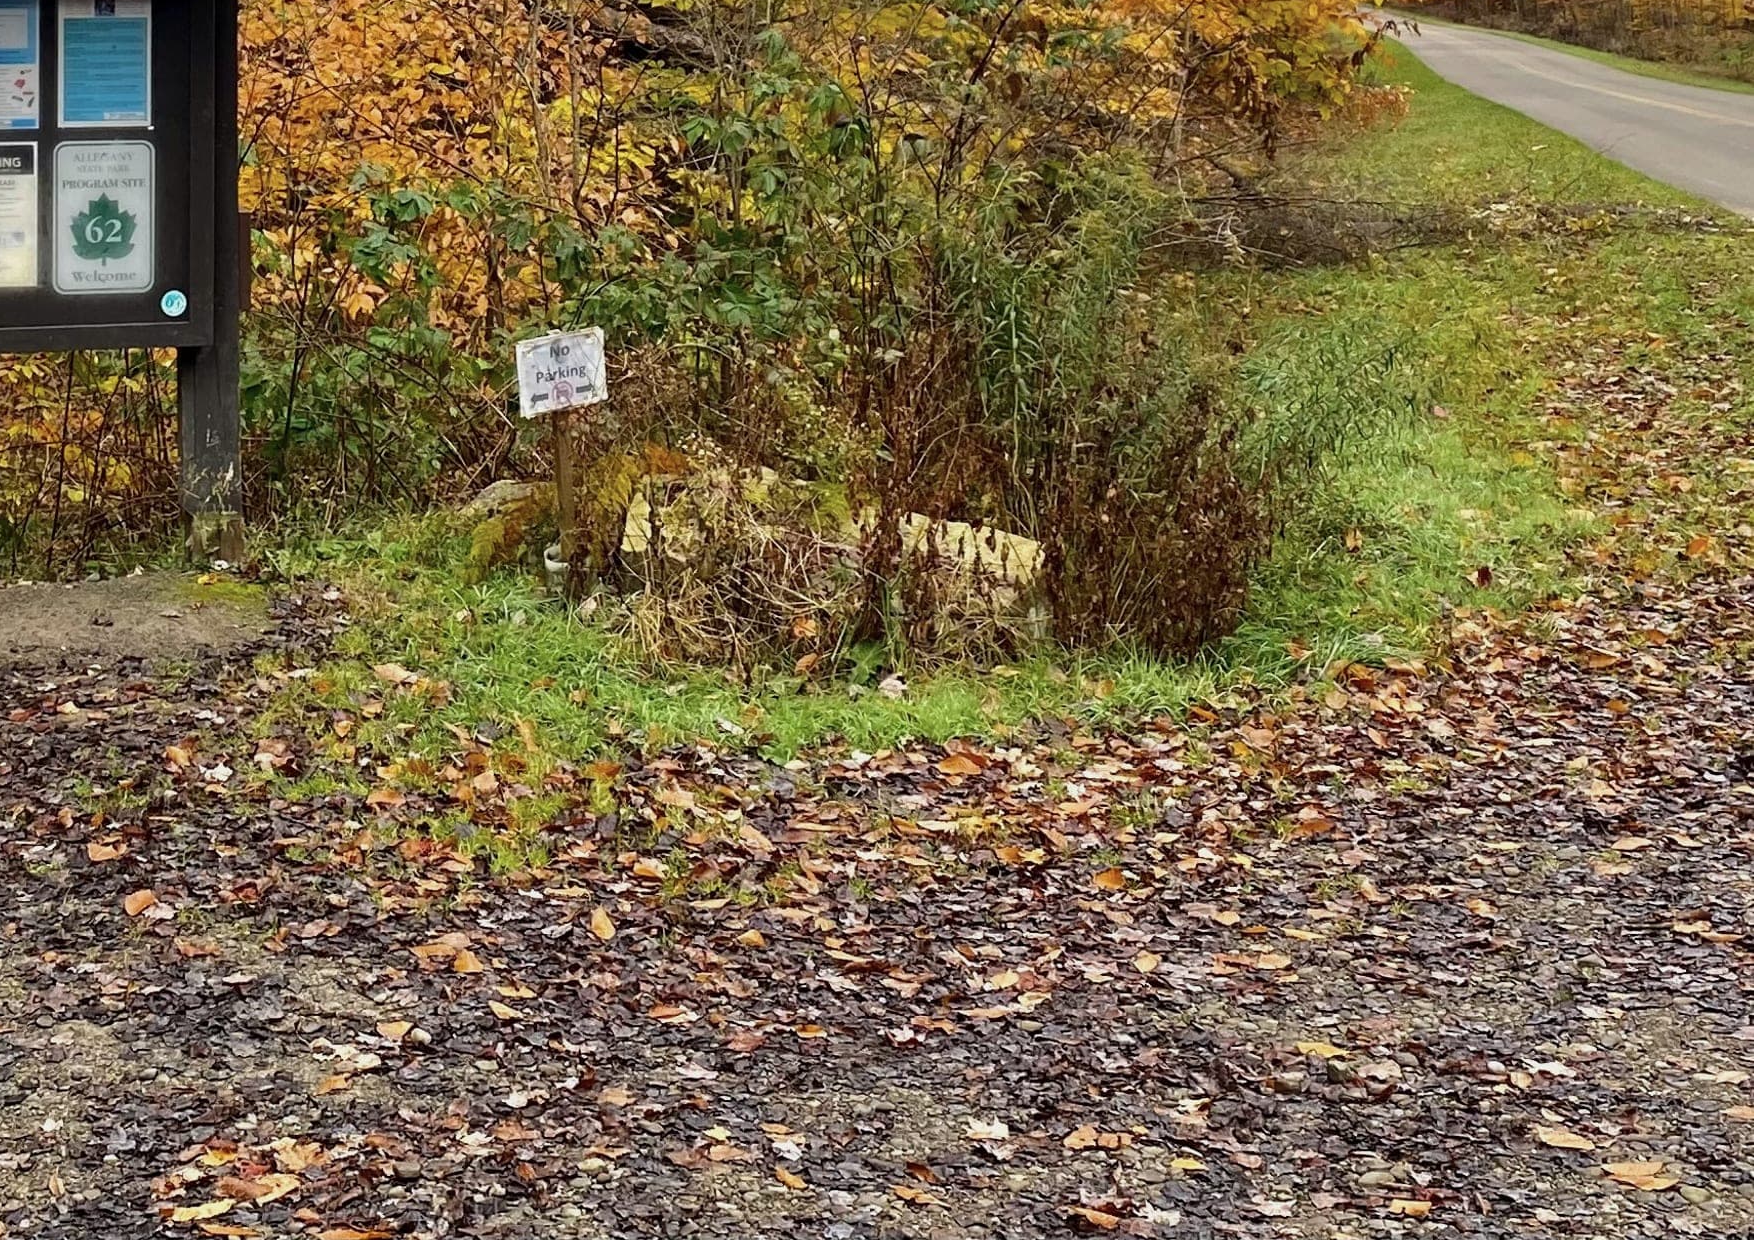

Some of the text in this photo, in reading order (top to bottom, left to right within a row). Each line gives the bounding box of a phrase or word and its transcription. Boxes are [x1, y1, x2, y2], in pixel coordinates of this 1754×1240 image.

[73, 152, 134, 162] ALLEGANY
[62, 178, 146, 189] PROGRAM SITE
[85, 215, 123, 243] 62
[72, 270, 137, 283] Welcome
[549, 344, 570, 358] No
[536, 364, 587, 383] Parking
